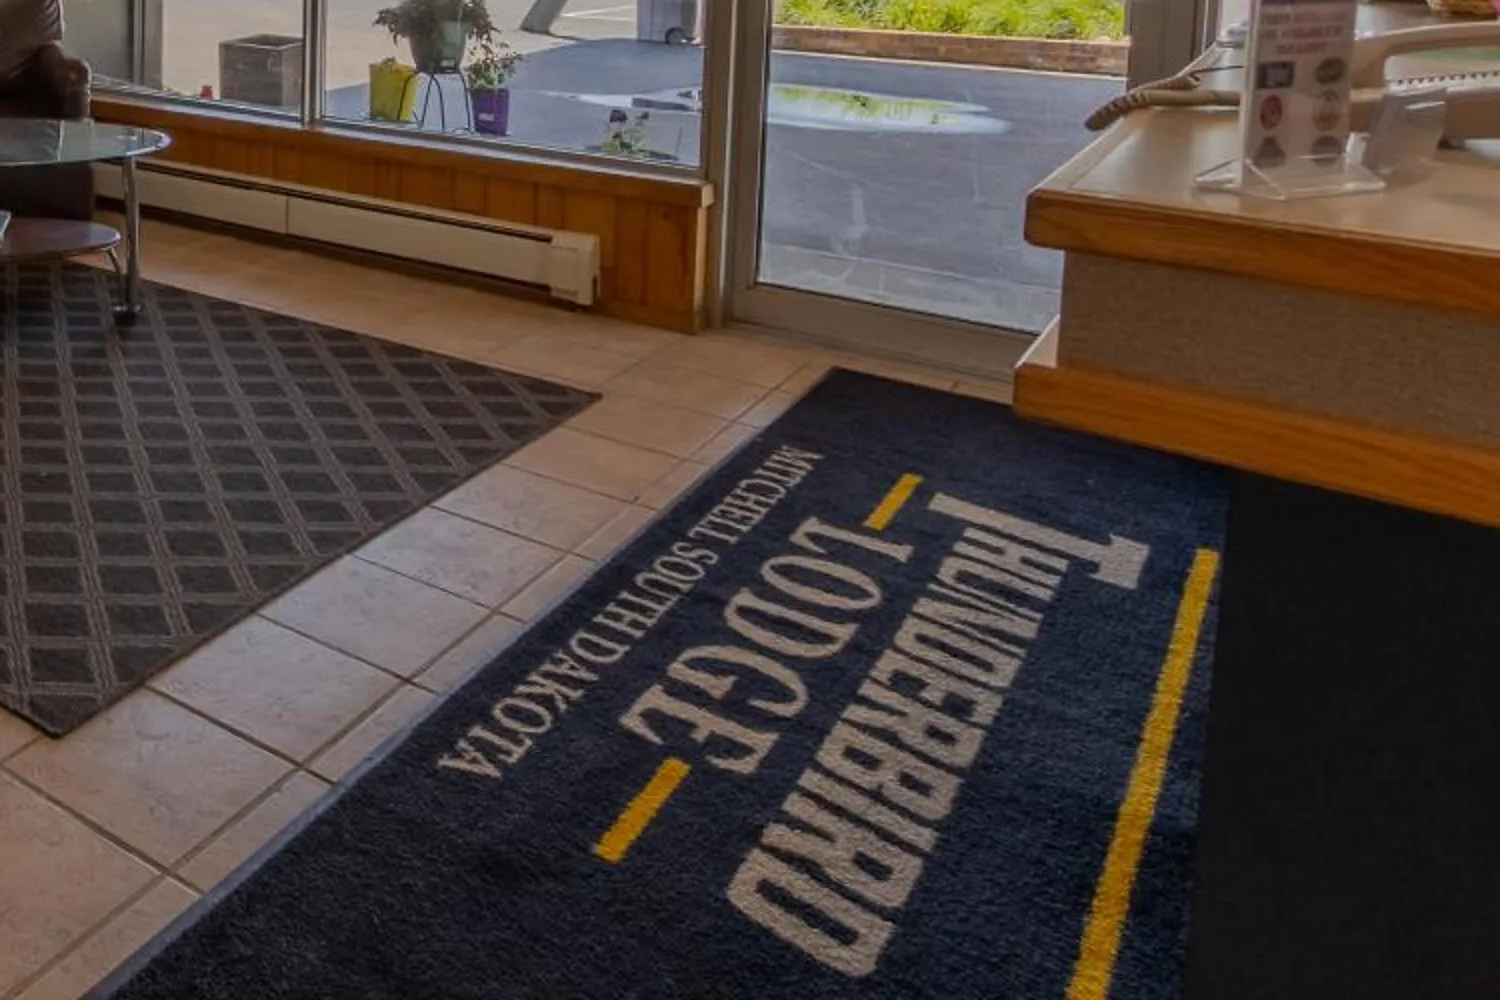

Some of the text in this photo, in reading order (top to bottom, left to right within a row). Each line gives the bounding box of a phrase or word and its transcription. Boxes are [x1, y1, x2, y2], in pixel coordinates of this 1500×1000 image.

[437, 444, 824, 779] MITCHELL SOUTH DAKOTA
[619, 516, 915, 775] LODGE
[727, 491, 1152, 979] THUNDERBIRD
